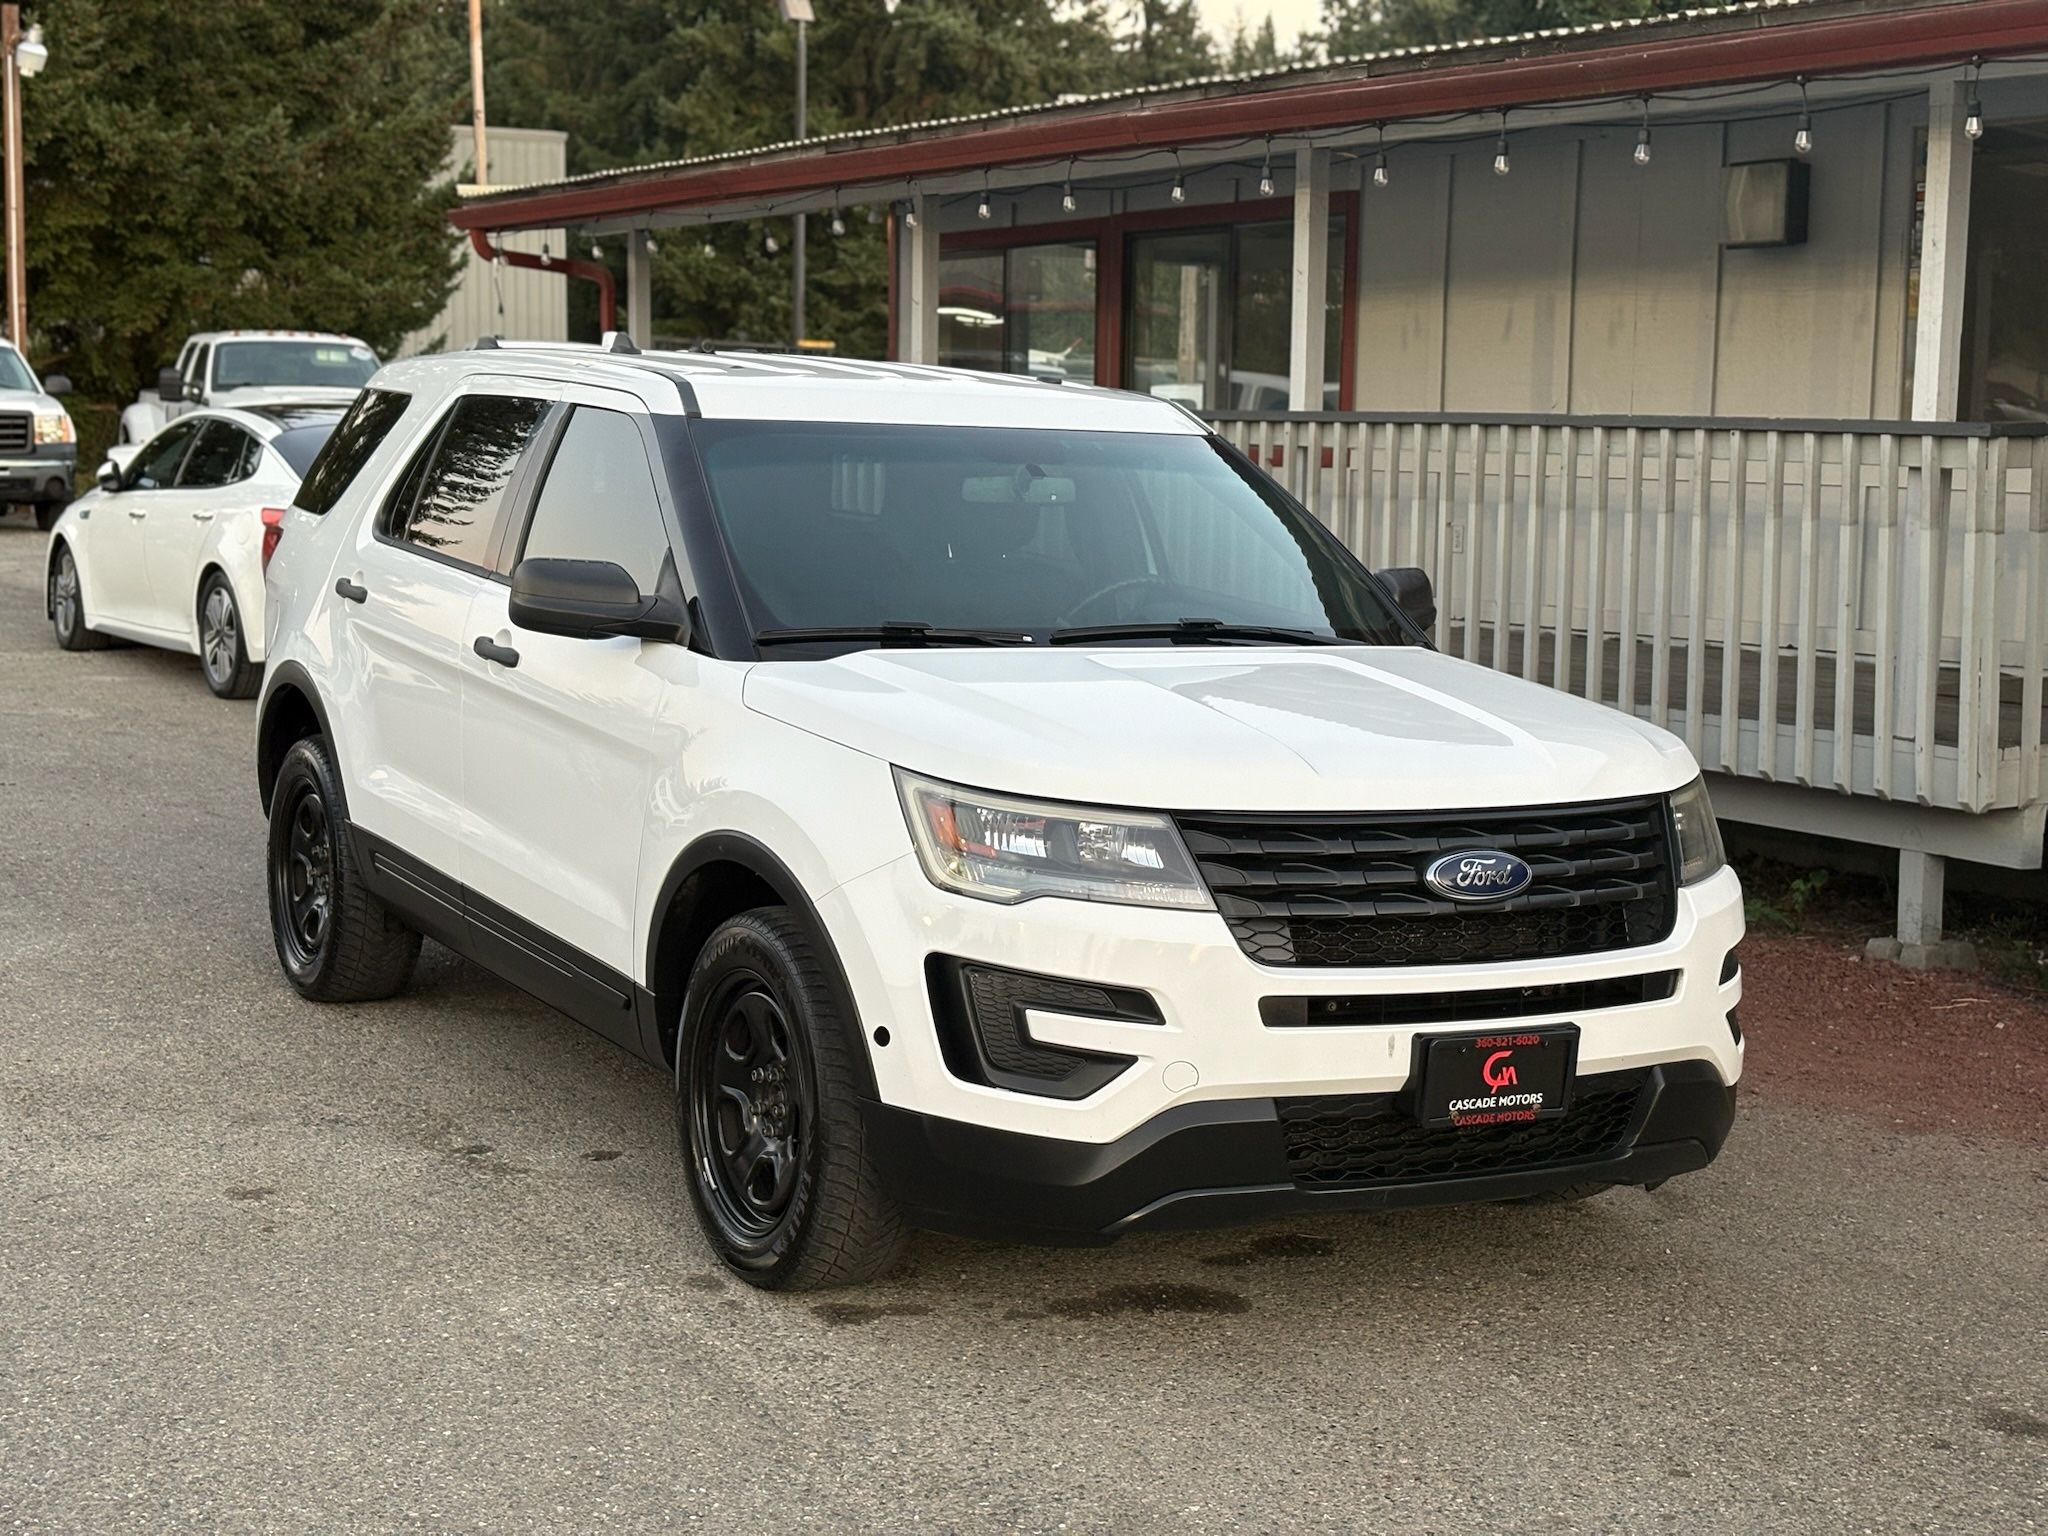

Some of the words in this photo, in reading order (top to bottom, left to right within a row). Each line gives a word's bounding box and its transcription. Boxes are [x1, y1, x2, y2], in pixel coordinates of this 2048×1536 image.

[1457, 859, 1512, 887] Ford
[1449, 1096, 1497, 1111] CASCADE
[1499, 1092, 1543, 1107] MOTORS
[1455, 1112, 1496, 1126] CASCADE
[1497, 1109, 1536, 1122] MOTORS
